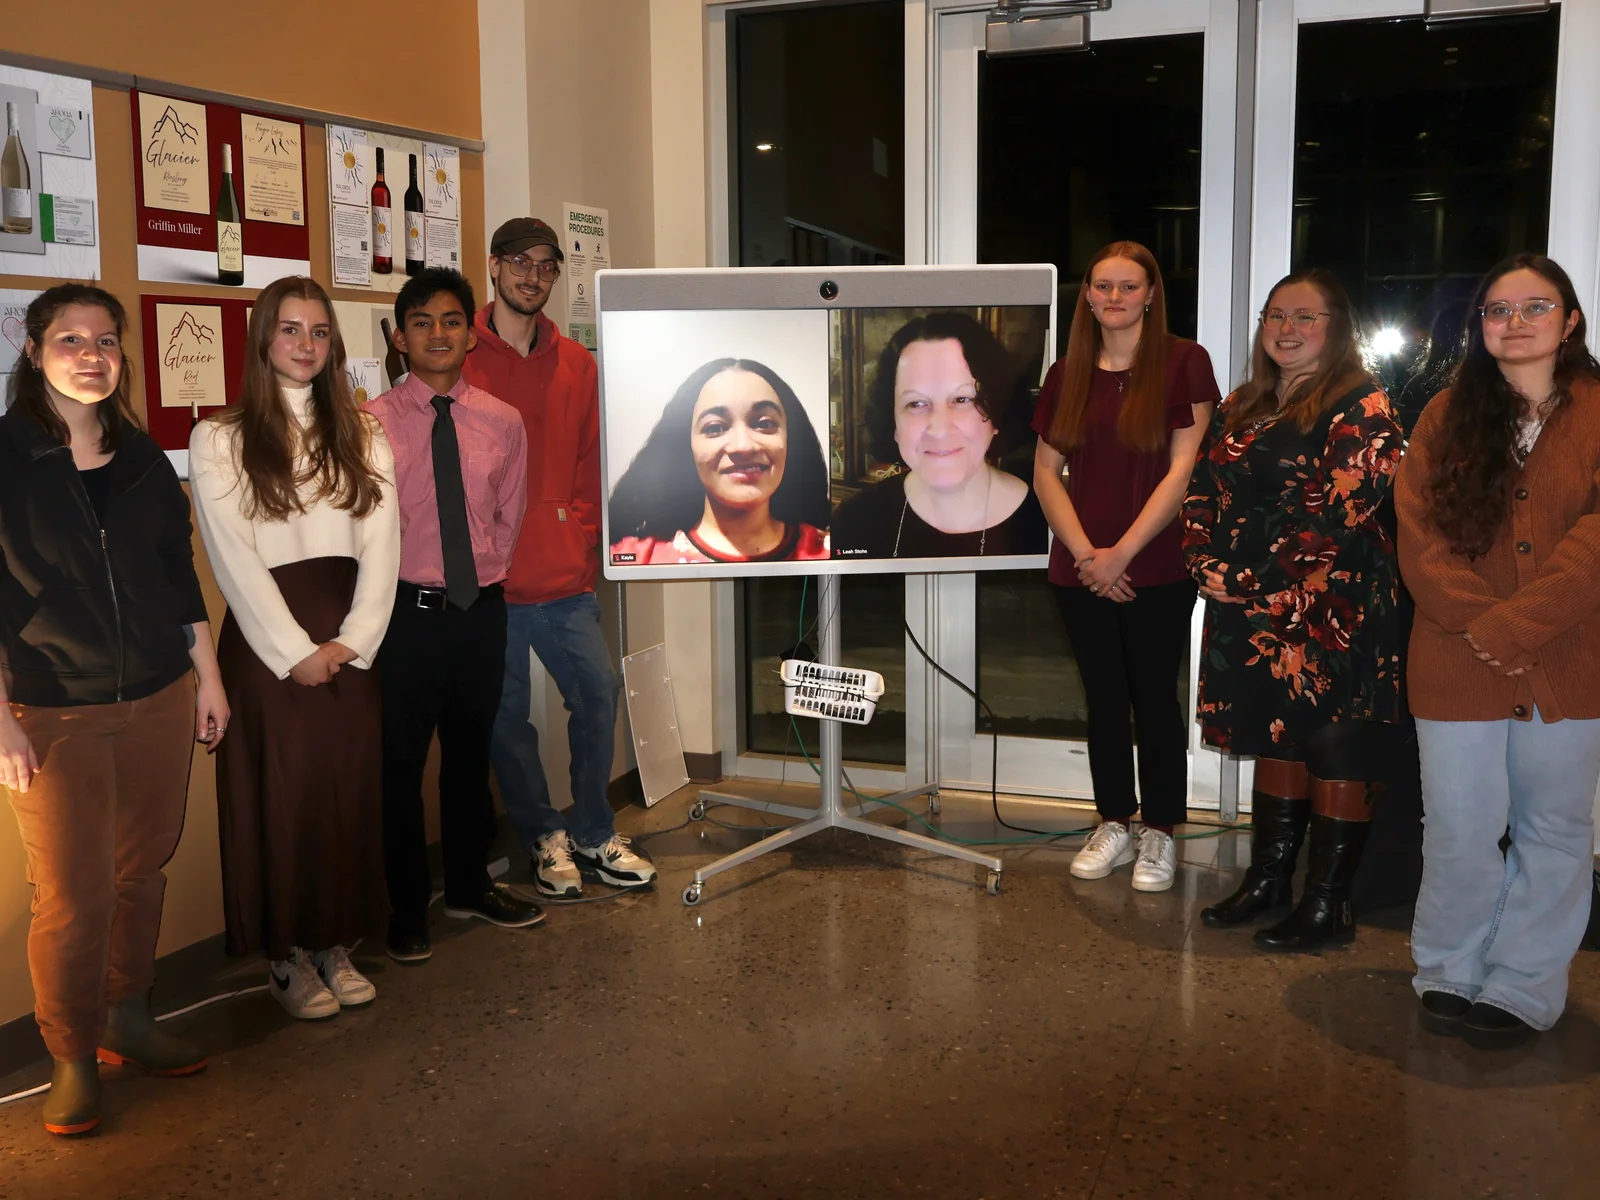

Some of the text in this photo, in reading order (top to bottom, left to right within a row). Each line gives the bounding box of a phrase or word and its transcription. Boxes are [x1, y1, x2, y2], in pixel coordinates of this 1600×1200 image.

[146, 139, 201, 168] Glacier
[569, 211, 603, 226] EMERGENCY
[147, 219, 203, 235] Griffin Miller
[568, 222, 605, 237] PROCEDURES
[163, 342, 216, 371] Glacier
[183, 369, 200, 383] Red
